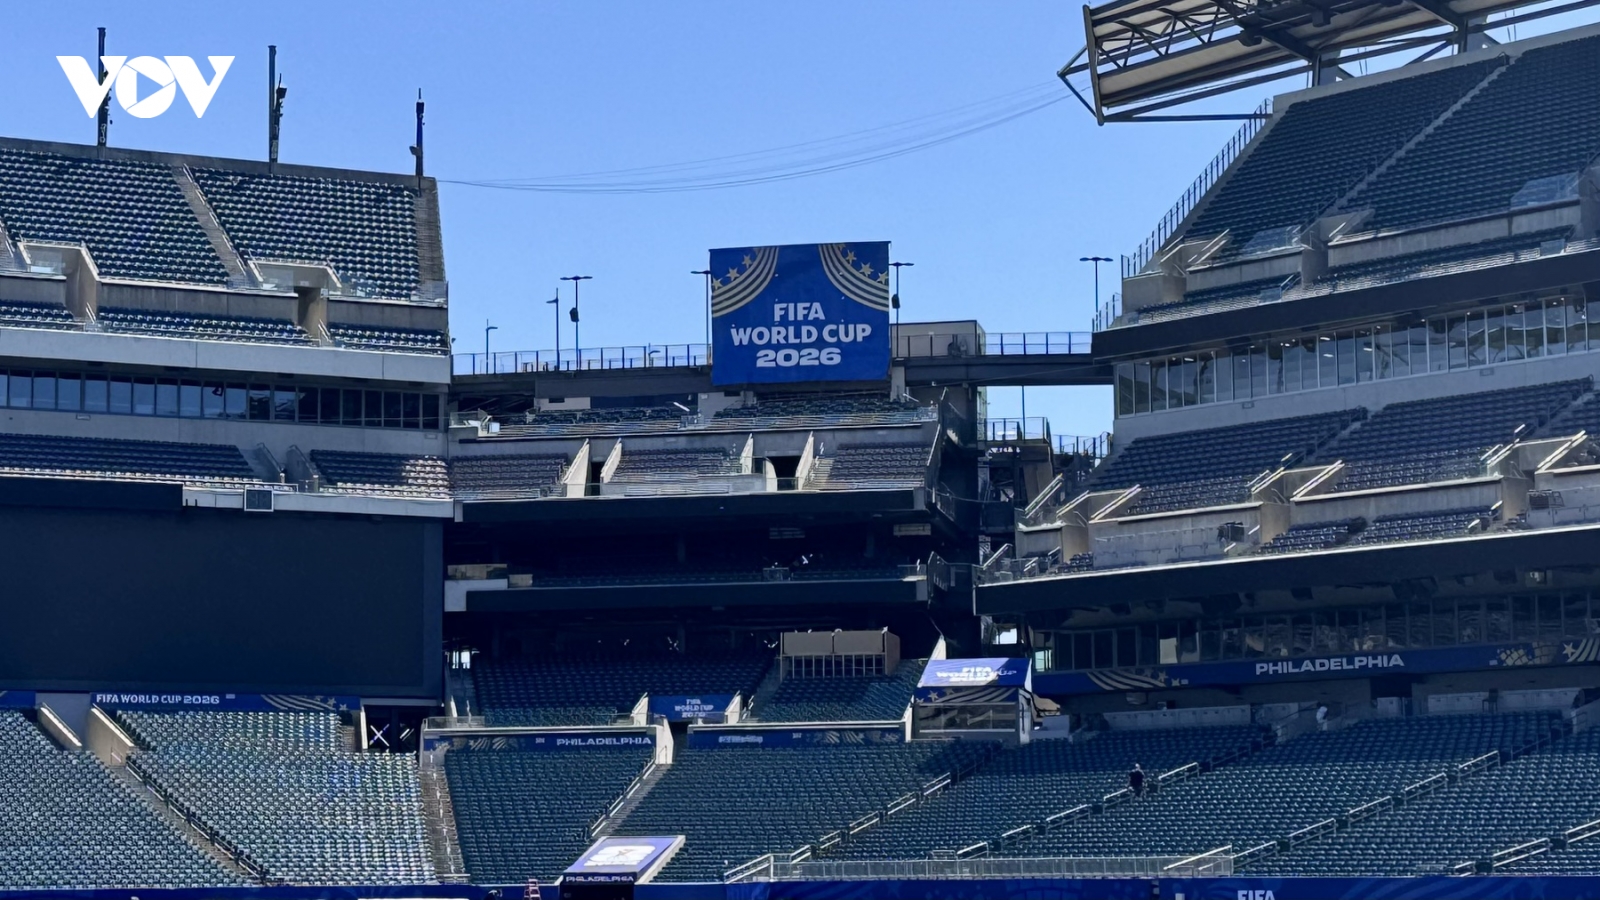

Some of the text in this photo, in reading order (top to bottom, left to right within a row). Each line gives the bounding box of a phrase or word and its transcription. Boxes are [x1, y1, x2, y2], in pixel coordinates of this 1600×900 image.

[774, 302, 825, 321] FIFA
[730, 324, 872, 346] WORLD CUP
[756, 348, 841, 367] 2026
[1255, 654, 1405, 675] PHILADELPHIA
[96, 694, 220, 704] FIFA WORLD CUP 2026
[556, 738, 652, 746] PHILADELPHIA
[1237, 890, 1276, 900] FIFA
